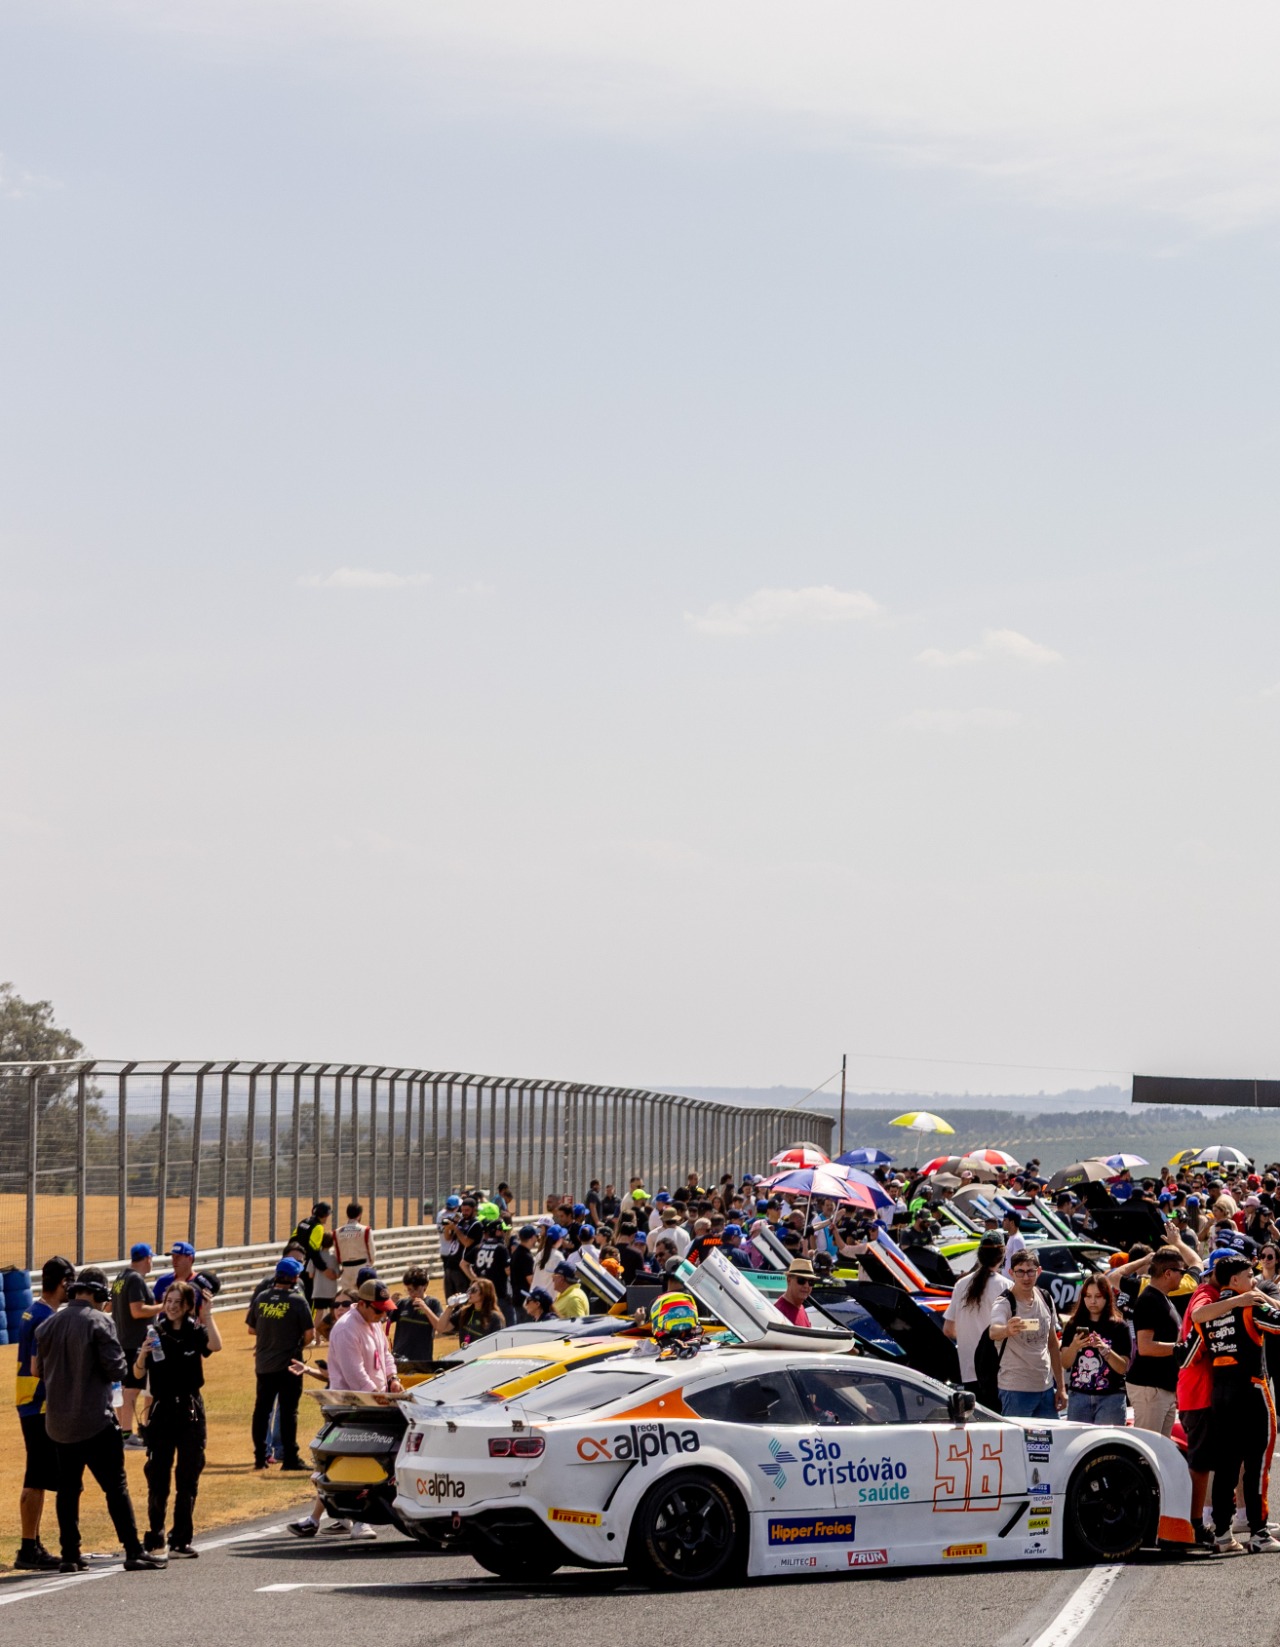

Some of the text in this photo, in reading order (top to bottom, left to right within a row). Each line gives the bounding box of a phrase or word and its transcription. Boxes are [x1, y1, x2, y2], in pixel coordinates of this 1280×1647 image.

[476, 1250, 495, 1268] 84
[637, 1423, 658, 1433] rede
[614, 1423, 700, 1467] alpha
[798, 1438, 841, 1461] São
[803, 1457, 907, 1486] Cristóvão
[428, 1473, 466, 1503] alpha
[858, 1482, 910, 1502] saúde
[552, 1509, 597, 1525] PIRELLI
[771, 1521, 852, 1542] Hipper Freios
[850, 1552, 886, 1565] FRUM
[946, 1543, 983, 1557] PIRELLI
[780, 1556, 809, 1567] MILITEC
